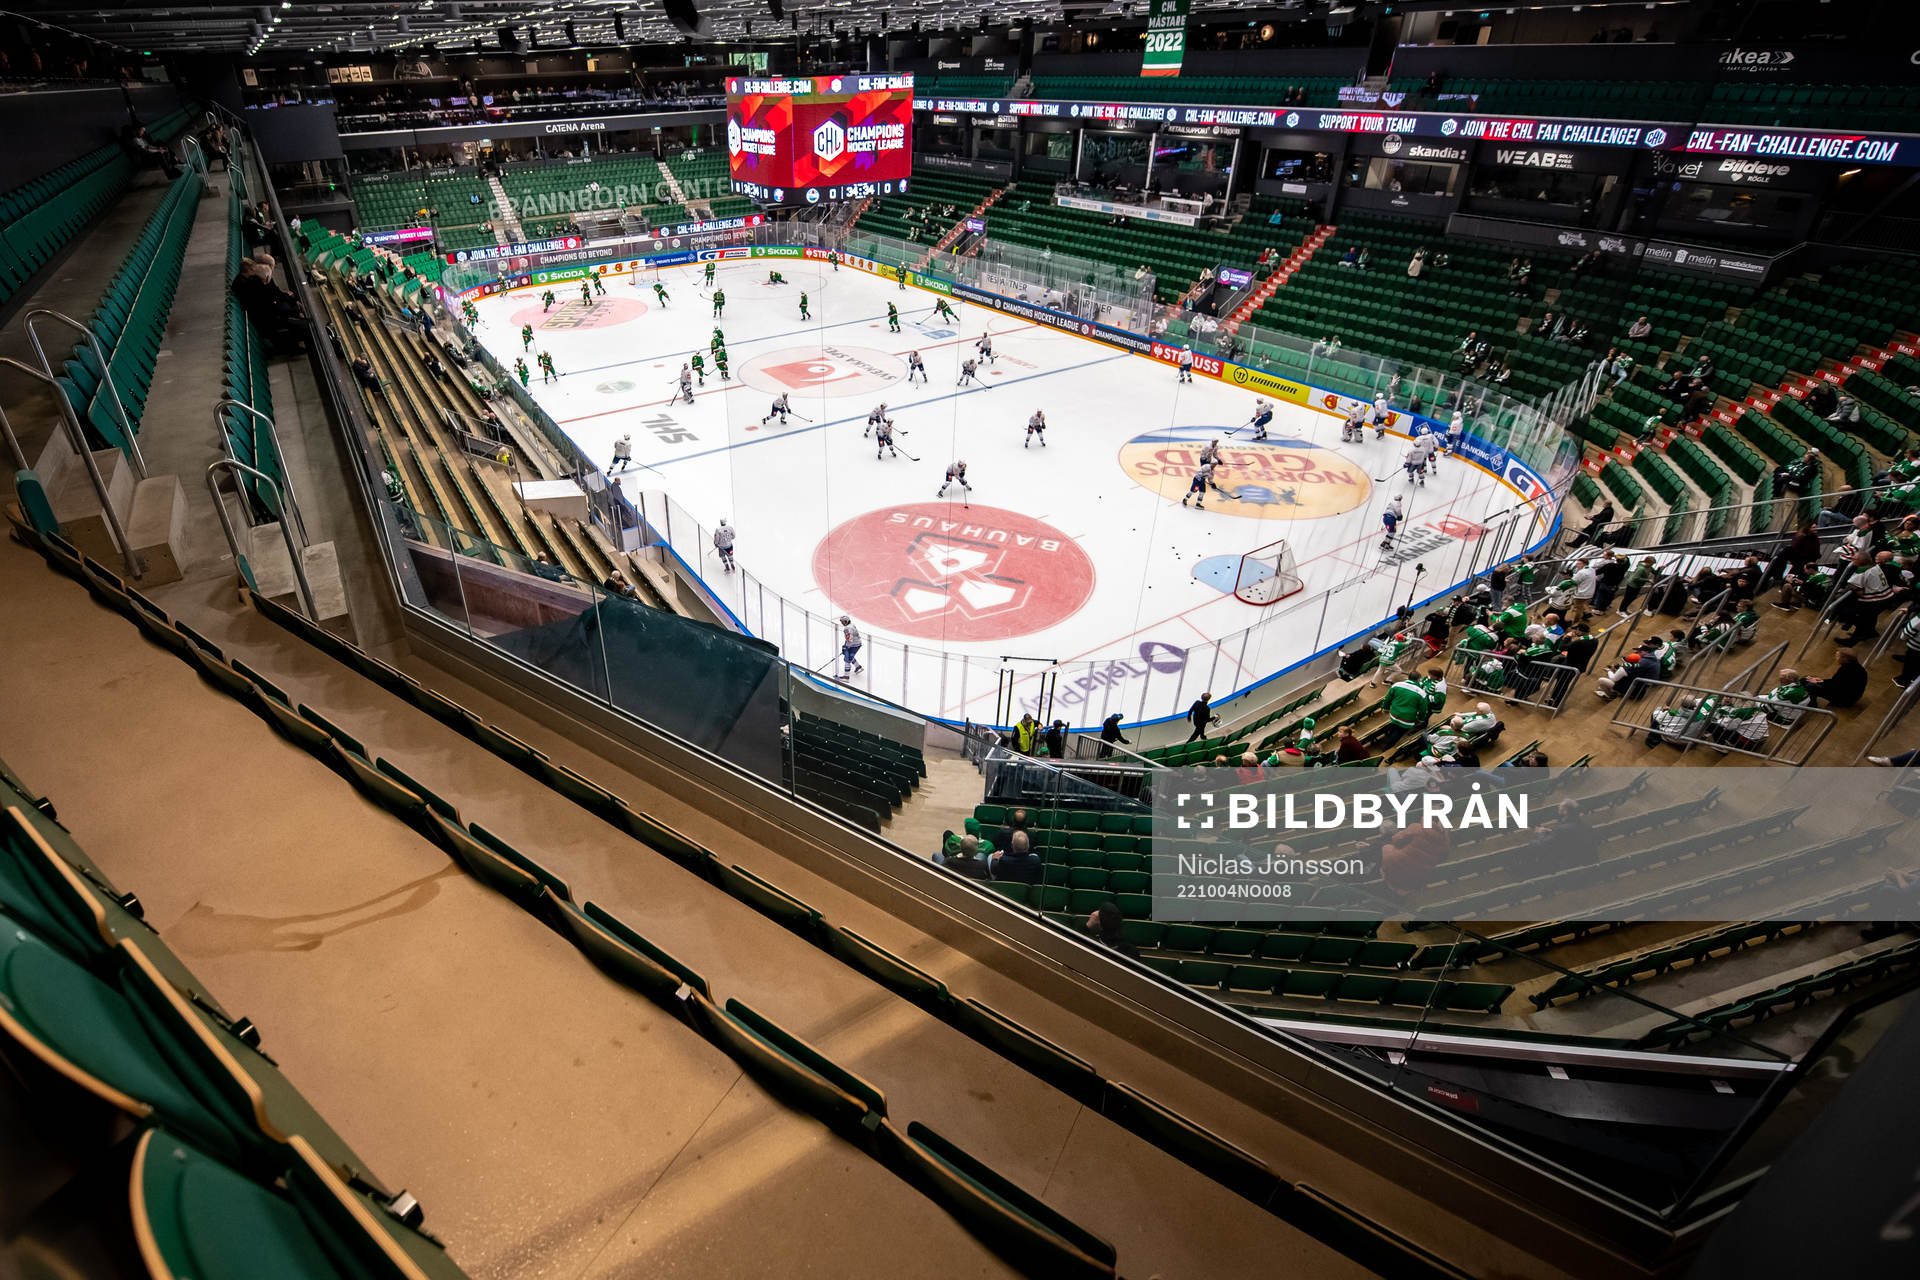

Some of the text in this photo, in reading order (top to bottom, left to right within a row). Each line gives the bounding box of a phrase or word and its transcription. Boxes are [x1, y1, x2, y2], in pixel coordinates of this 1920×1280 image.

[1161, 1, 1177, 12] CHL
[1148, 14, 1187, 28] MÄSTARE
[1145, 32, 1184, 52] 2022
[1718, 48, 1771, 64] akea
[1009, 103, 1060, 116] SUPPORT YOUR TEAM!
[1080, 105, 1165, 121] JOIN THE CHL FAN CHALLENGE!
[1185, 109, 1276, 126] CHL-FAN-CHALLENGE.COM
[545, 121, 606, 134] CATENA Arena
[847, 123, 904, 141] CHAMPIONS
[1318, 114, 1417, 133] SUPPORT YOUR TEAM!
[1460, 120, 1641, 145] JOIN THE CHL FAN CHALLENGE!
[741, 127, 776, 145] CHAMPIONS
[816, 125, 842, 156] CHL
[847, 137, 904, 153] HOCKEY LEAGUE
[1686, 130, 1900, 162] CHL-FAN-CHALLENGE.COM
[1496, 150, 1558, 168] WEAB
[1718, 158, 1791, 176] Bildeve
[1747, 175, 1770, 183] RÖGLE
[829, 182, 892, 199] 0 34:34 0
[676, 217, 746, 235] CHL-FAN-CHALLENGE.COM
[470, 240, 565, 261] JOIN THE CHL FAN CHALLENGE!
[540, 248, 613, 265] CHAMPIONS GO BEYOND
[767, 247, 799, 256] ŠKODA
[1645, 247, 1673, 259] melin
[1687, 254, 1717, 266] melin
[550, 269, 585, 280] ŠKODA
[924, 278, 949, 292] ŠKODA
[1002, 301, 1079, 332] CHAMPIONS HOCKEY LEAGUE
[1249, 375, 1299, 395] WARRIOR
[641, 413, 700, 445] SHL
[1460, 441, 1490, 462] BANKING
[890, 512, 1061, 552] BAUHAUS
[1379, 534, 1454, 567] SVENSKA
[1019, 661, 1147, 713] Telia Play
